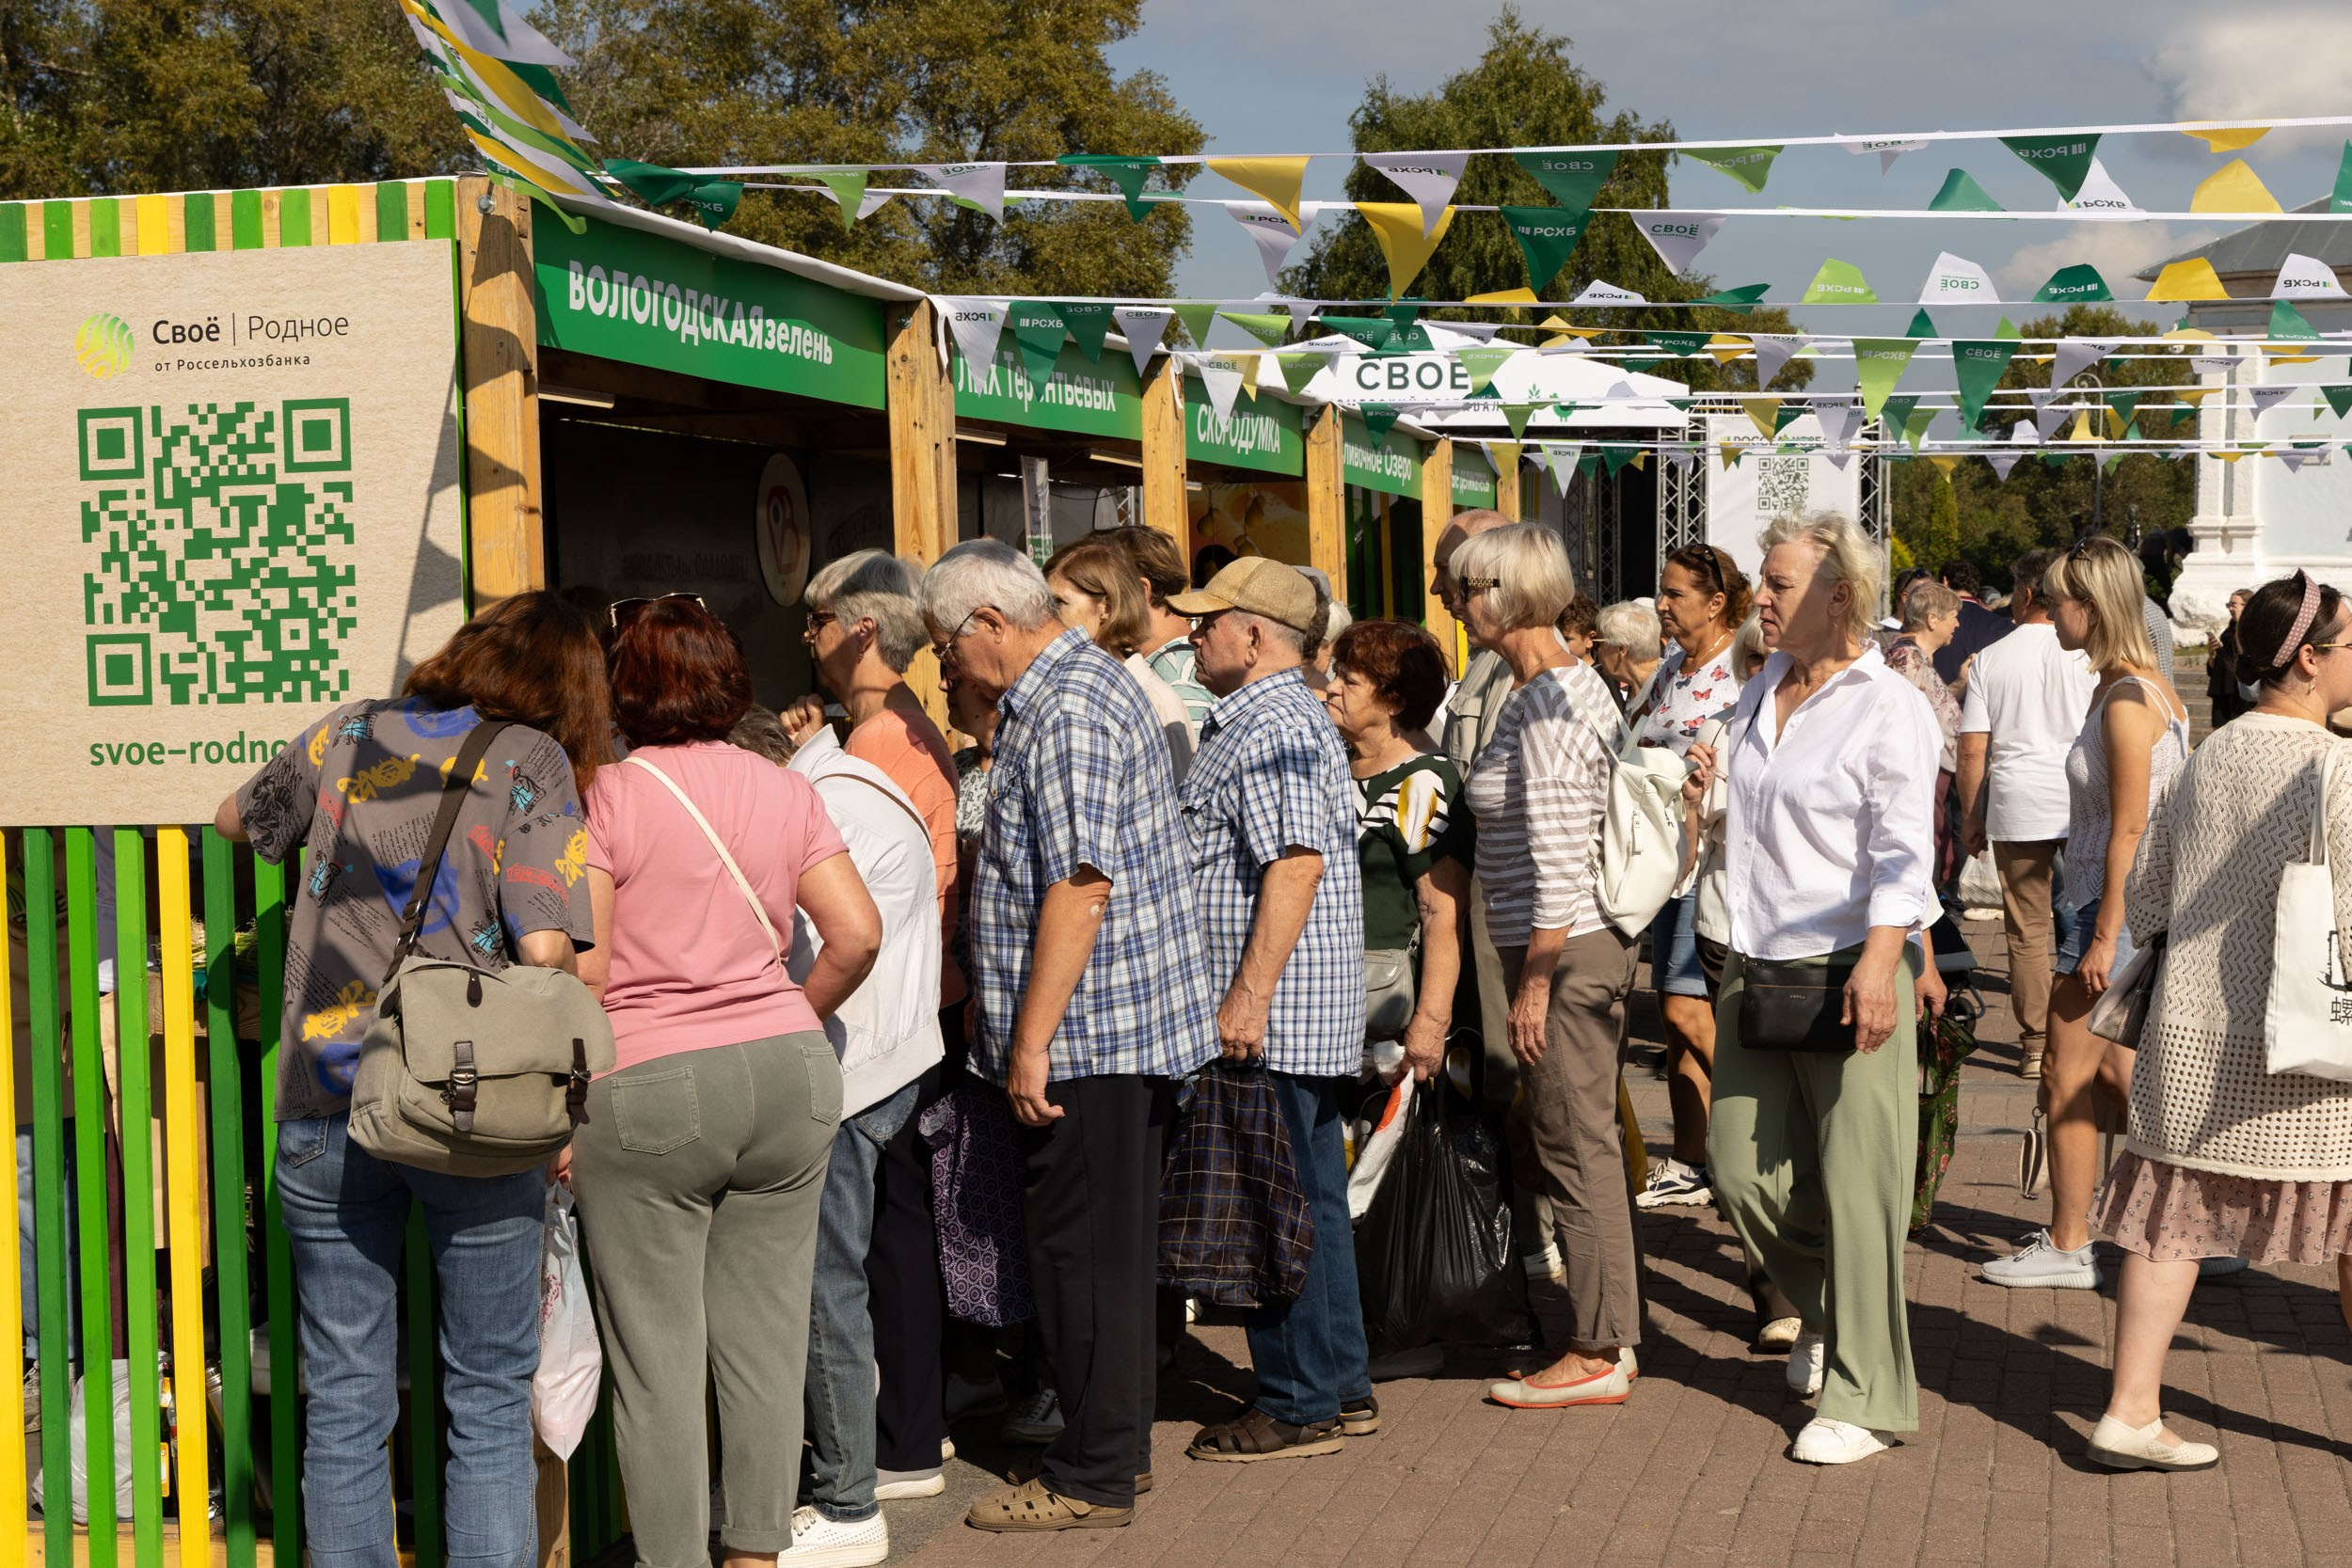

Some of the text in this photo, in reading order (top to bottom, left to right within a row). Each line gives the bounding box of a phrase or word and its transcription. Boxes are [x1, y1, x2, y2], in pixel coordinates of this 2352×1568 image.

[1258, 216, 1299, 225] РСХ
[1534, 227, 1576, 236] РСХБ
[1651, 224, 1699, 235] СВОЁ
[1817, 284, 1851, 293] РСХБ
[1940, 279, 1979, 291] СВОЁ
[2049, 286, 2085, 294] РСХБ
[1032, 319, 1064, 328] РСХБ
[152, 316, 349, 344] Своё Родное
[1665, 339, 1696, 348] РСХБ
[1873, 351, 1906, 361] РСХБ
[1965, 348, 2001, 358] СВОЁ
[155, 355, 310, 372] от Россельхозбанка
[1209, 360, 1237, 370] СВОЁ
[1003, 351, 1116, 412] Тернтьевых
[1385, 445, 1411, 487] Озеро
